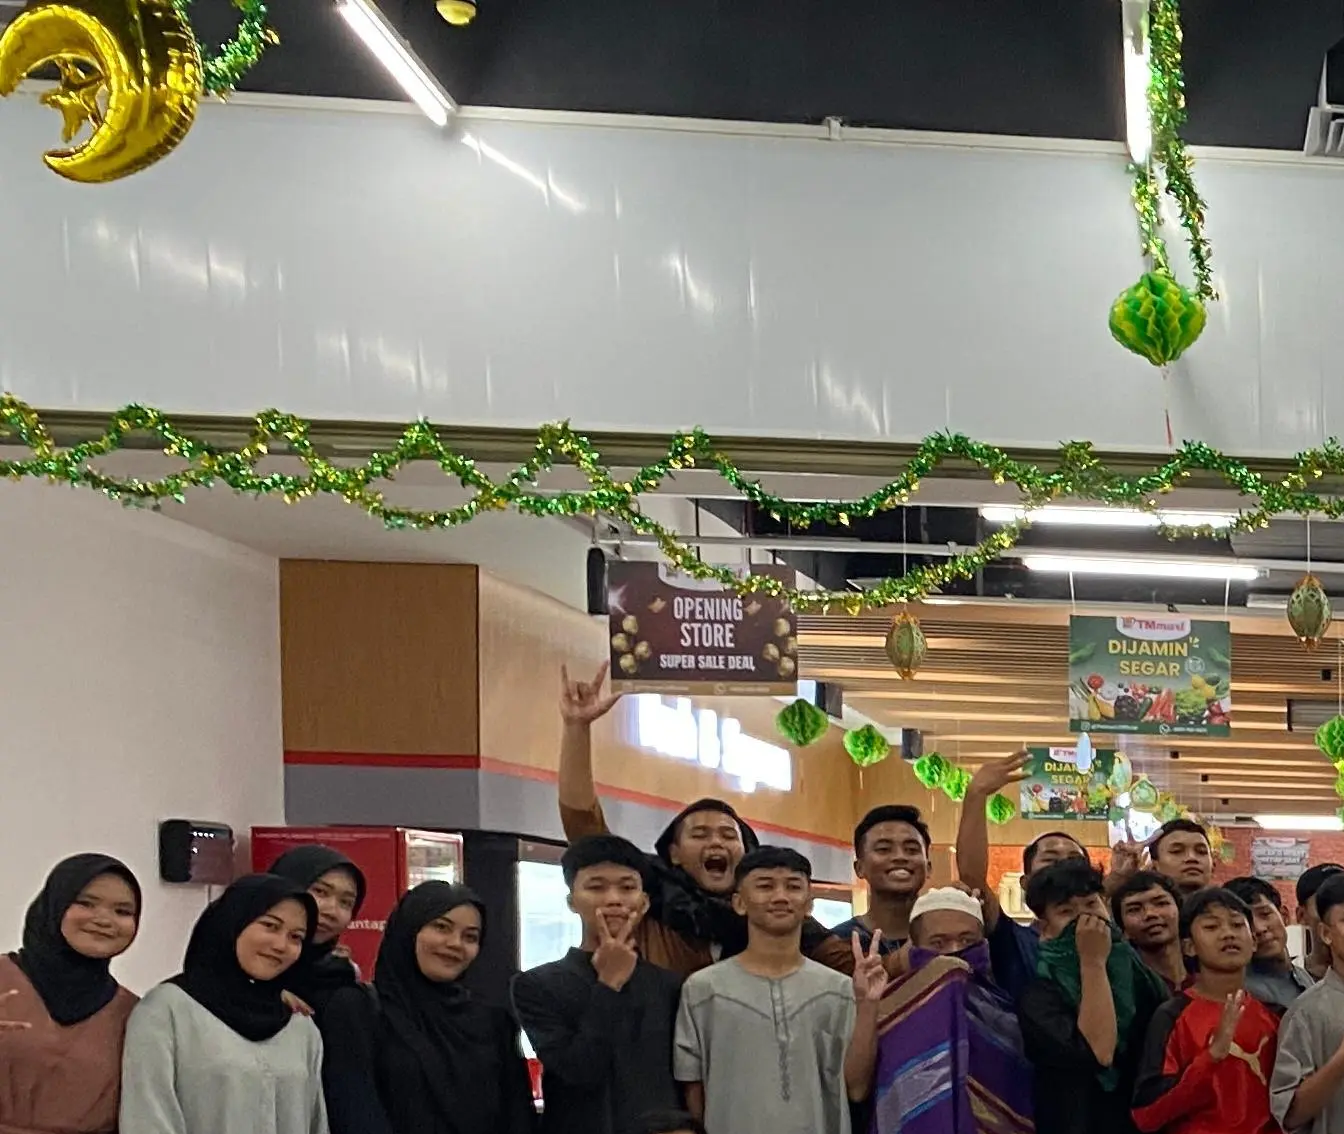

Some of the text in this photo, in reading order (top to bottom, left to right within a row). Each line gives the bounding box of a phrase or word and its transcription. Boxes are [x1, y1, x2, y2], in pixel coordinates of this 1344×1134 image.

[674, 597, 743, 620] OPENING
[680, 623, 735, 648] STORE
[1108, 640, 1188, 656] DIJAMIN
[660, 654, 755, 671] SUPER SALE DEAL
[1120, 660, 1180, 676] SEGAR
